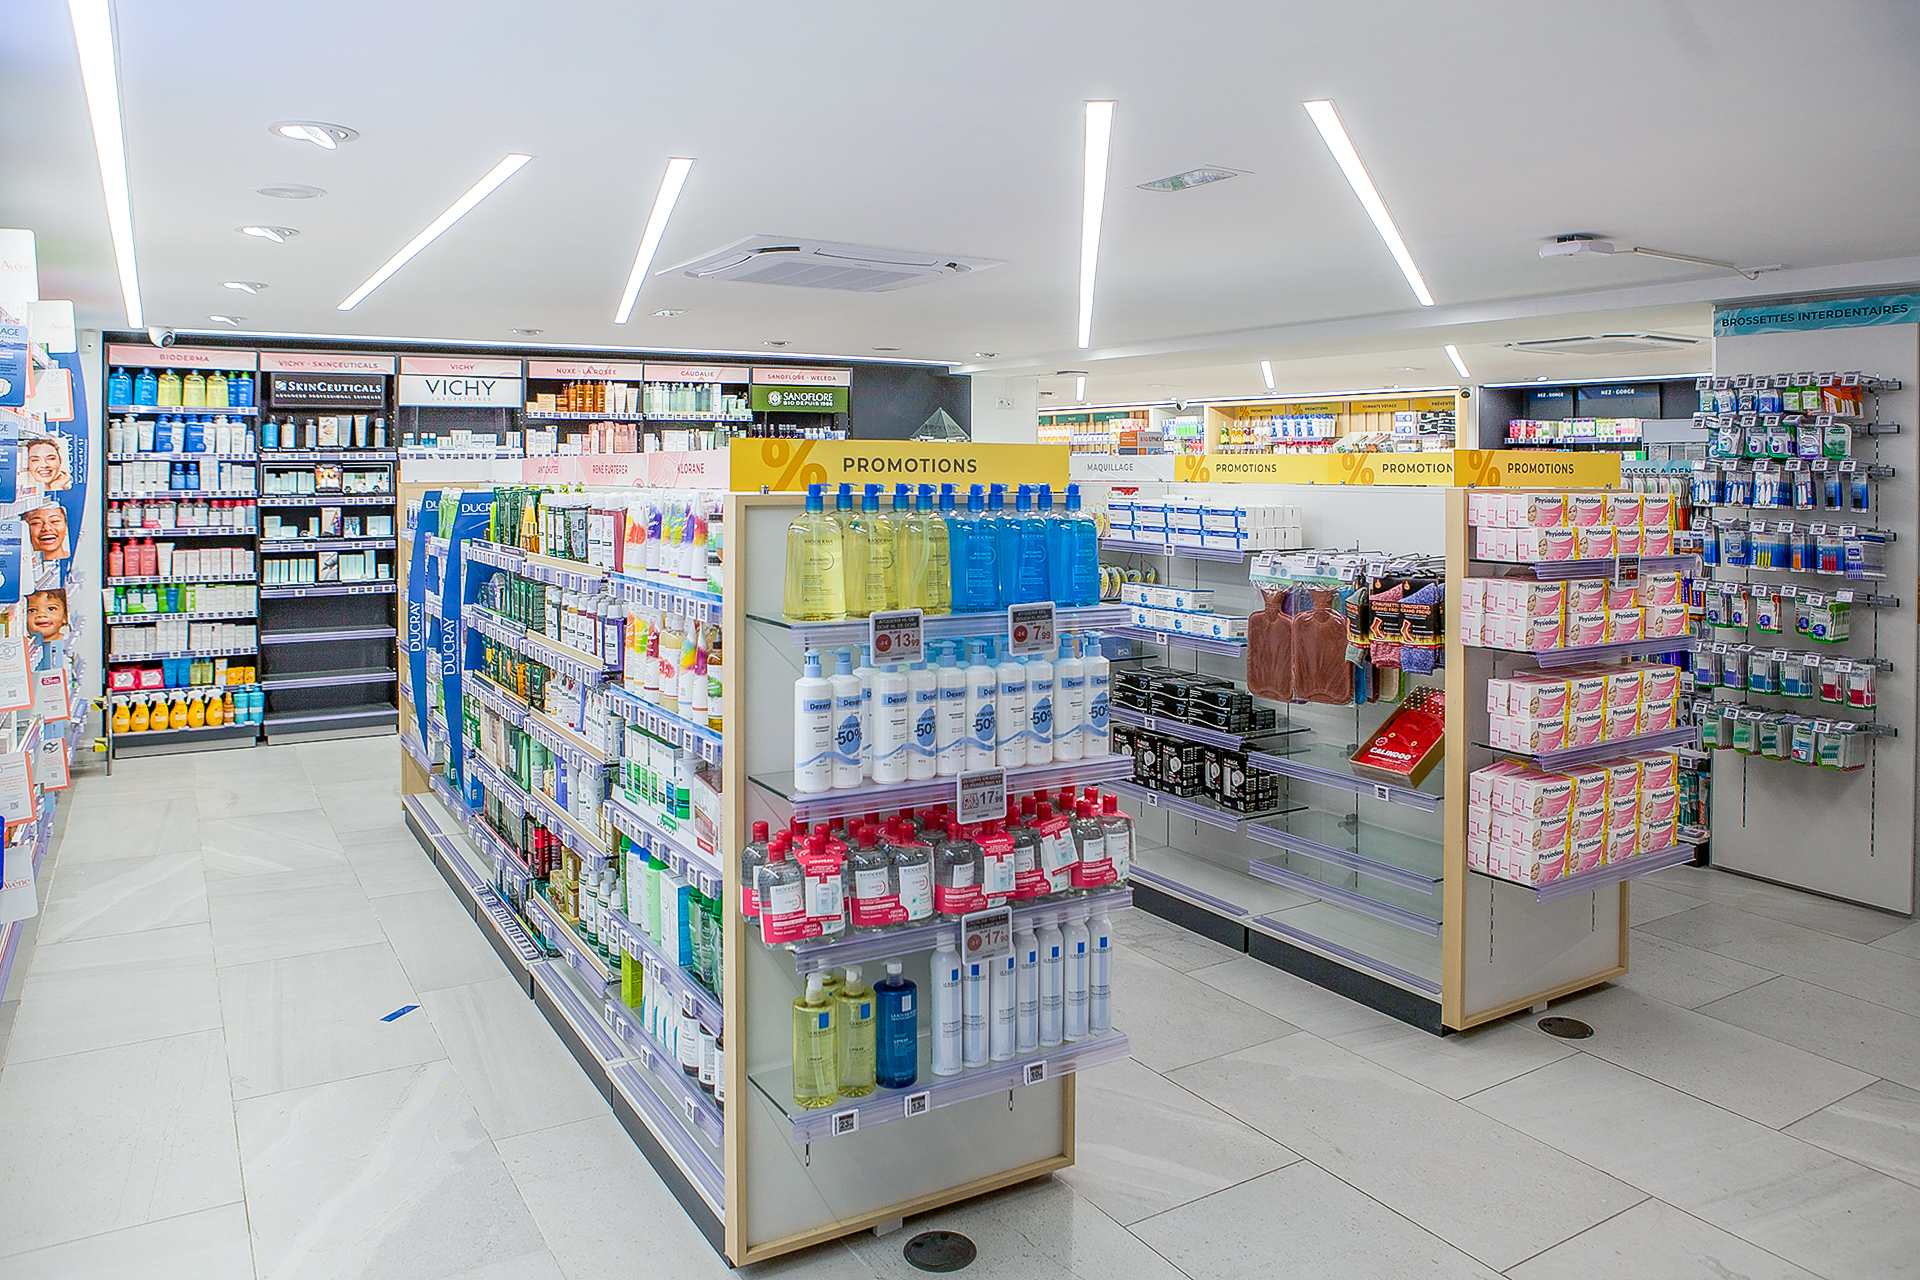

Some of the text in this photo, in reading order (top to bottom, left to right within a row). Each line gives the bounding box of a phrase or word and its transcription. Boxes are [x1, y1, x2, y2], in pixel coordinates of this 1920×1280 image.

[1722, 303, 1908, 327] BROSSETTES INTERDENTAIRES
[0, 328, 20, 336] AGE
[159, 354, 210, 363] BIODERMA
[313, 360, 379, 369] SKINCEUTICALS
[426, 380, 497, 396] VICHY
[783, 391, 834, 401] SANOFLORE
[677, 463, 705, 474] KLORANE
[842, 457, 978, 473] PROMOTIONS
[1087, 463, 1134, 472] MAQUILLAGE
[1215, 463, 1277, 473] PROMOTIONS
[1382, 463, 1453, 473] PROMOTION
[1507, 462, 1574, 474] PROMOTIONS
[1534, 496, 1562, 504] Physiodose
[1576, 497, 1602, 505] Physiodose
[462, 503, 491, 512] DUCR
[1545, 530, 1573, 538] Physiodose
[1586, 528, 1612, 537] Physiodose
[1645, 528, 1669, 536] Physiodose
[1653, 576, 1676, 585] Physiodose
[1535, 585, 1561, 594] Physiodose
[1578, 583, 1603, 591] Physiodose
[1578, 615, 1604, 624] Physiodose
[1615, 611, 1640, 620] Physiodose
[410, 600, 420, 652] DUCRAY
[1533, 619, 1559, 627] Physiodose
[894, 633, 910, 647] 13
[443, 617, 455, 676] DUCRAY
[1615, 676, 1638, 684] Physiodose
[1578, 681, 1603, 690] Physiodose
[1538, 686, 1566, 695] Physiodose
[1647, 702, 1671, 710] Physiodose
[1612, 707, 1636, 716] Physiodose
[1576, 714, 1601, 723] Physiodose
[1538, 720, 1564, 729] Physiodose
[1644, 760, 1671, 769] Physiodose
[1613, 767, 1637, 776] Physiodose
[1579, 776, 1605, 785] Physiodose
[1542, 785, 1570, 795] Physiodose
[980, 791, 995, 804] 17
[1651, 791, 1675, 800] Physiodose
[1613, 797, 1636, 807] Physiodose
[1579, 808, 1604, 818] Physiodose
[1540, 817, 1567, 827] Physiodose
[1649, 820, 1672, 830] Physiodose
[1616, 828, 1636, 838] Physiodose
[1577, 839, 1602, 849] Physiodose
[1538, 850, 1564, 860] Physiodose
[985, 931, 1000, 945] 17
